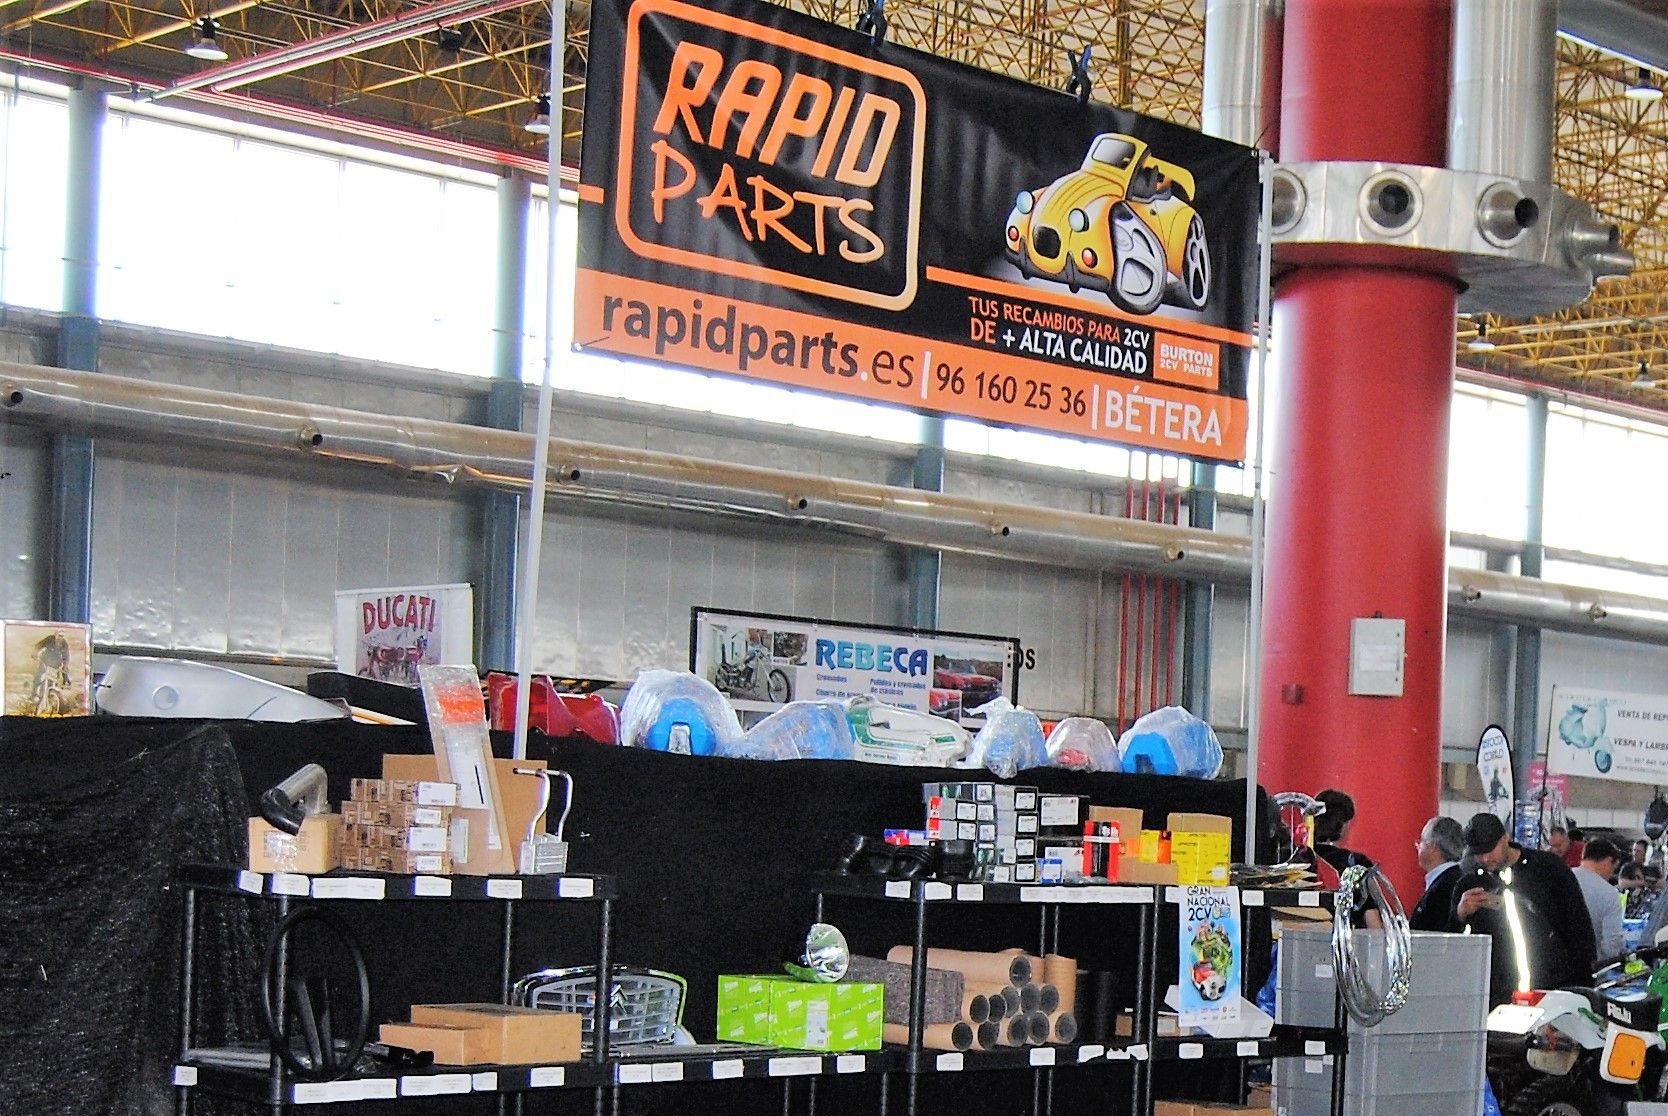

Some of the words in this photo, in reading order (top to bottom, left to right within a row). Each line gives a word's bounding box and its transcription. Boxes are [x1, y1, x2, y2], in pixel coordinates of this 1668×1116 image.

[653, 40, 902, 188] RAPID
[652, 141, 886, 263] PARTS
[968, 296, 999, 317] TUS
[1003, 304, 1084, 335] RECAMBIOS
[1088, 320, 1121, 343] PARA
[1123, 328, 1150, 350] 2CV
[970, 317, 997, 344] DE
[1019, 327, 1066, 359] ALTA
[1070, 338, 1148, 374] CALIDAD
[1160, 344, 1214, 365] BURTON
[602, 295, 915, 388] rapidparts.es
[937, 363, 966, 396] 96
[975, 371, 1017, 404] 160
[1024, 379, 1052, 410] 25
[1059, 386, 1086, 417] 36
[1104, 384, 1222, 446] BÉTERA
[1160, 358, 1178, 371] 2CV
[1183, 363, 1213, 377] PARTS
[363, 594, 436, 634] DUCATI
[815, 639, 929, 678] REBECA
[1617, 710, 1640, 719] VENTA
[1614, 738, 1637, 747] VESPA
[1187, 886, 1211, 896] GRAN
[1187, 896, 1231, 907] NACIONAL
[1188, 907, 1212, 921] 2CV
